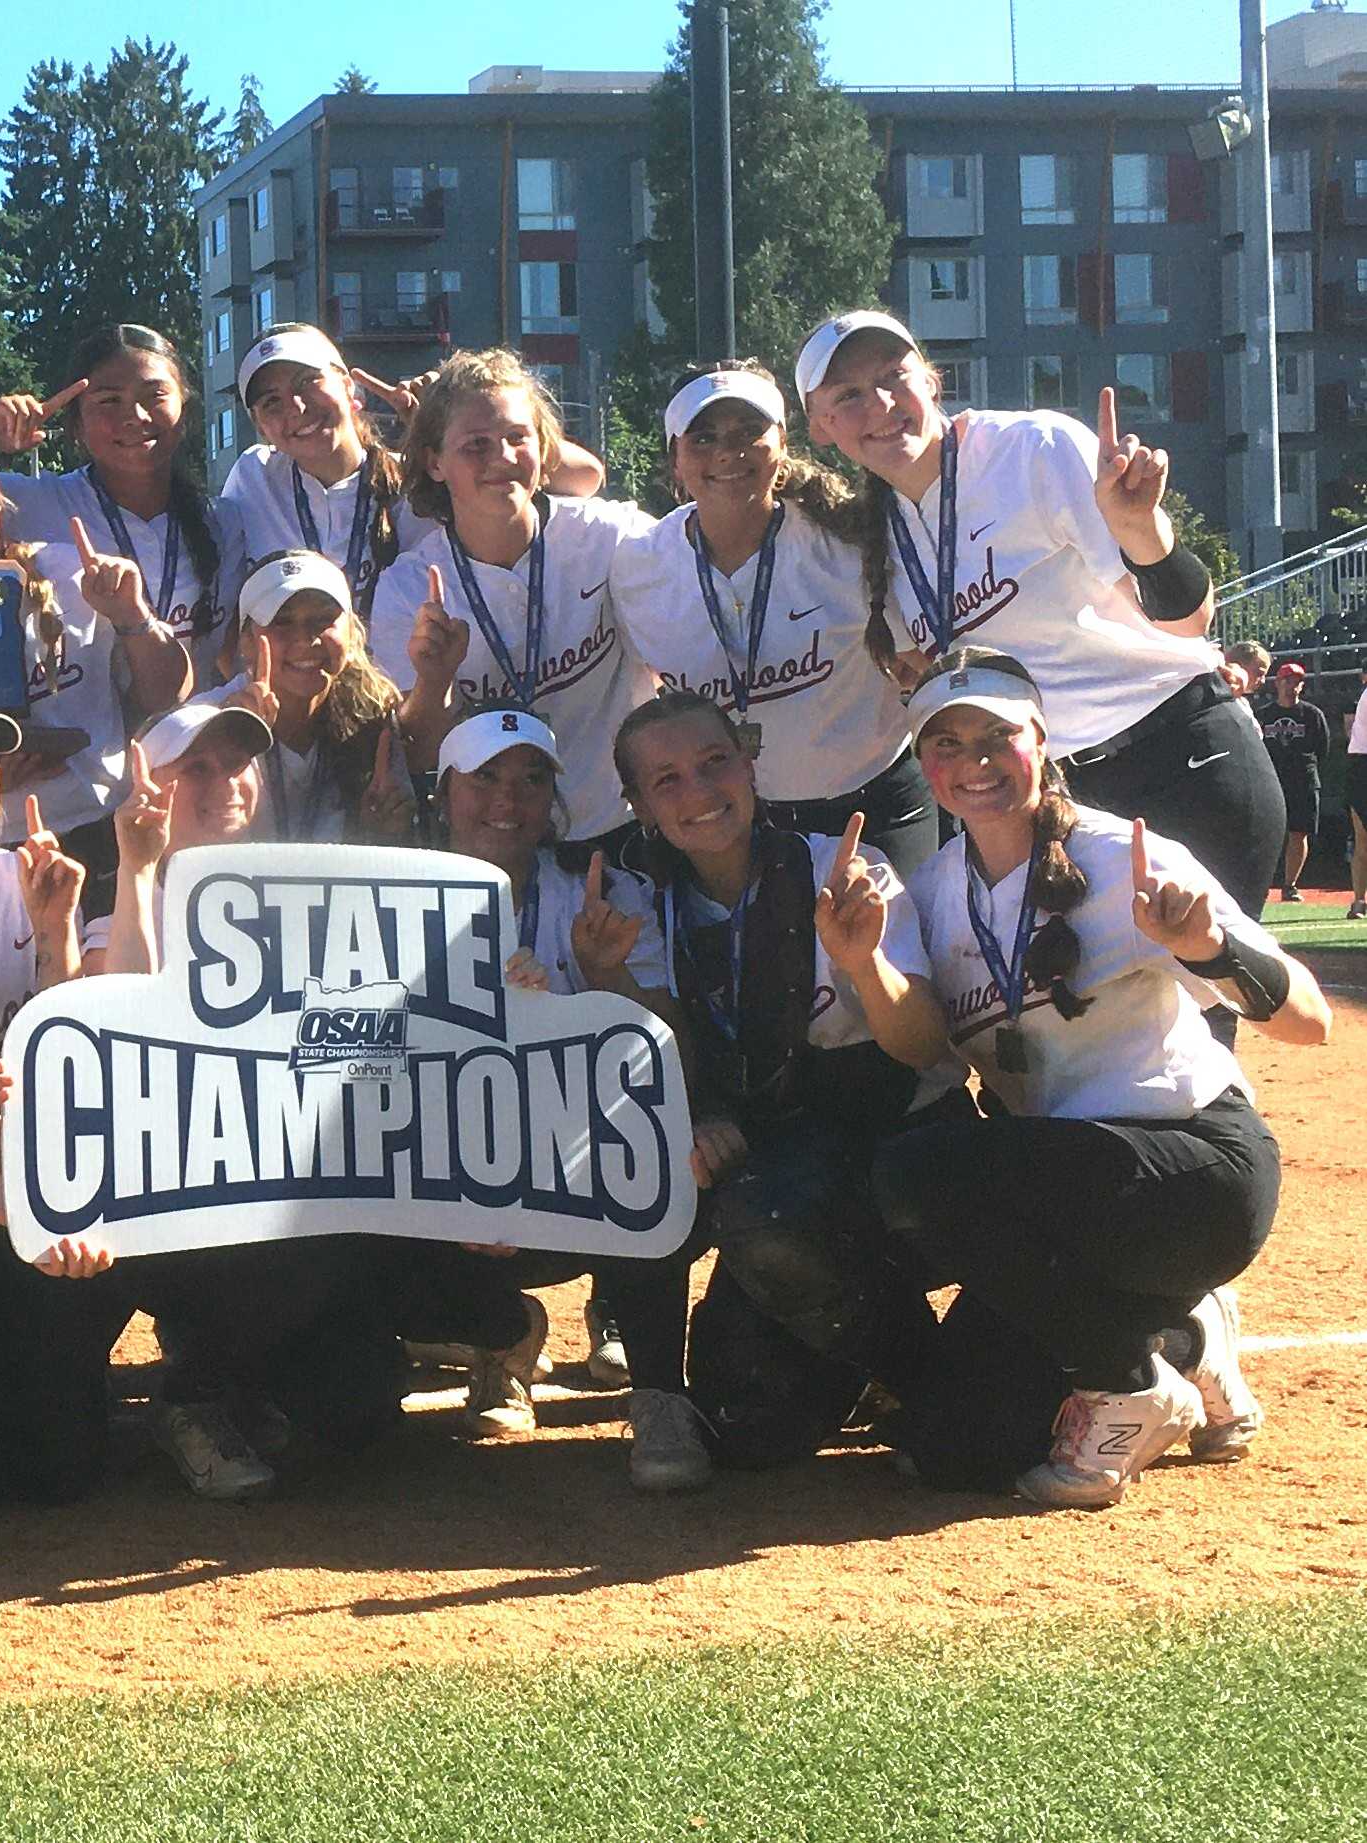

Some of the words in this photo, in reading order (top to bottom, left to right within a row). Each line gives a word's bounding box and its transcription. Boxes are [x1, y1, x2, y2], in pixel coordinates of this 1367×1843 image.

[501, 713, 520, 732] S
[187, 873, 507, 1042] STATE
[297, 1007, 408, 1047] OSAA
[297, 1048, 325, 1058] STATE
[326, 1048, 403, 1059] CHAMPIONSHIPS
[347, 1062, 392, 1076] OnPoint
[24, 1016, 670, 1236] CHAMPIONS
